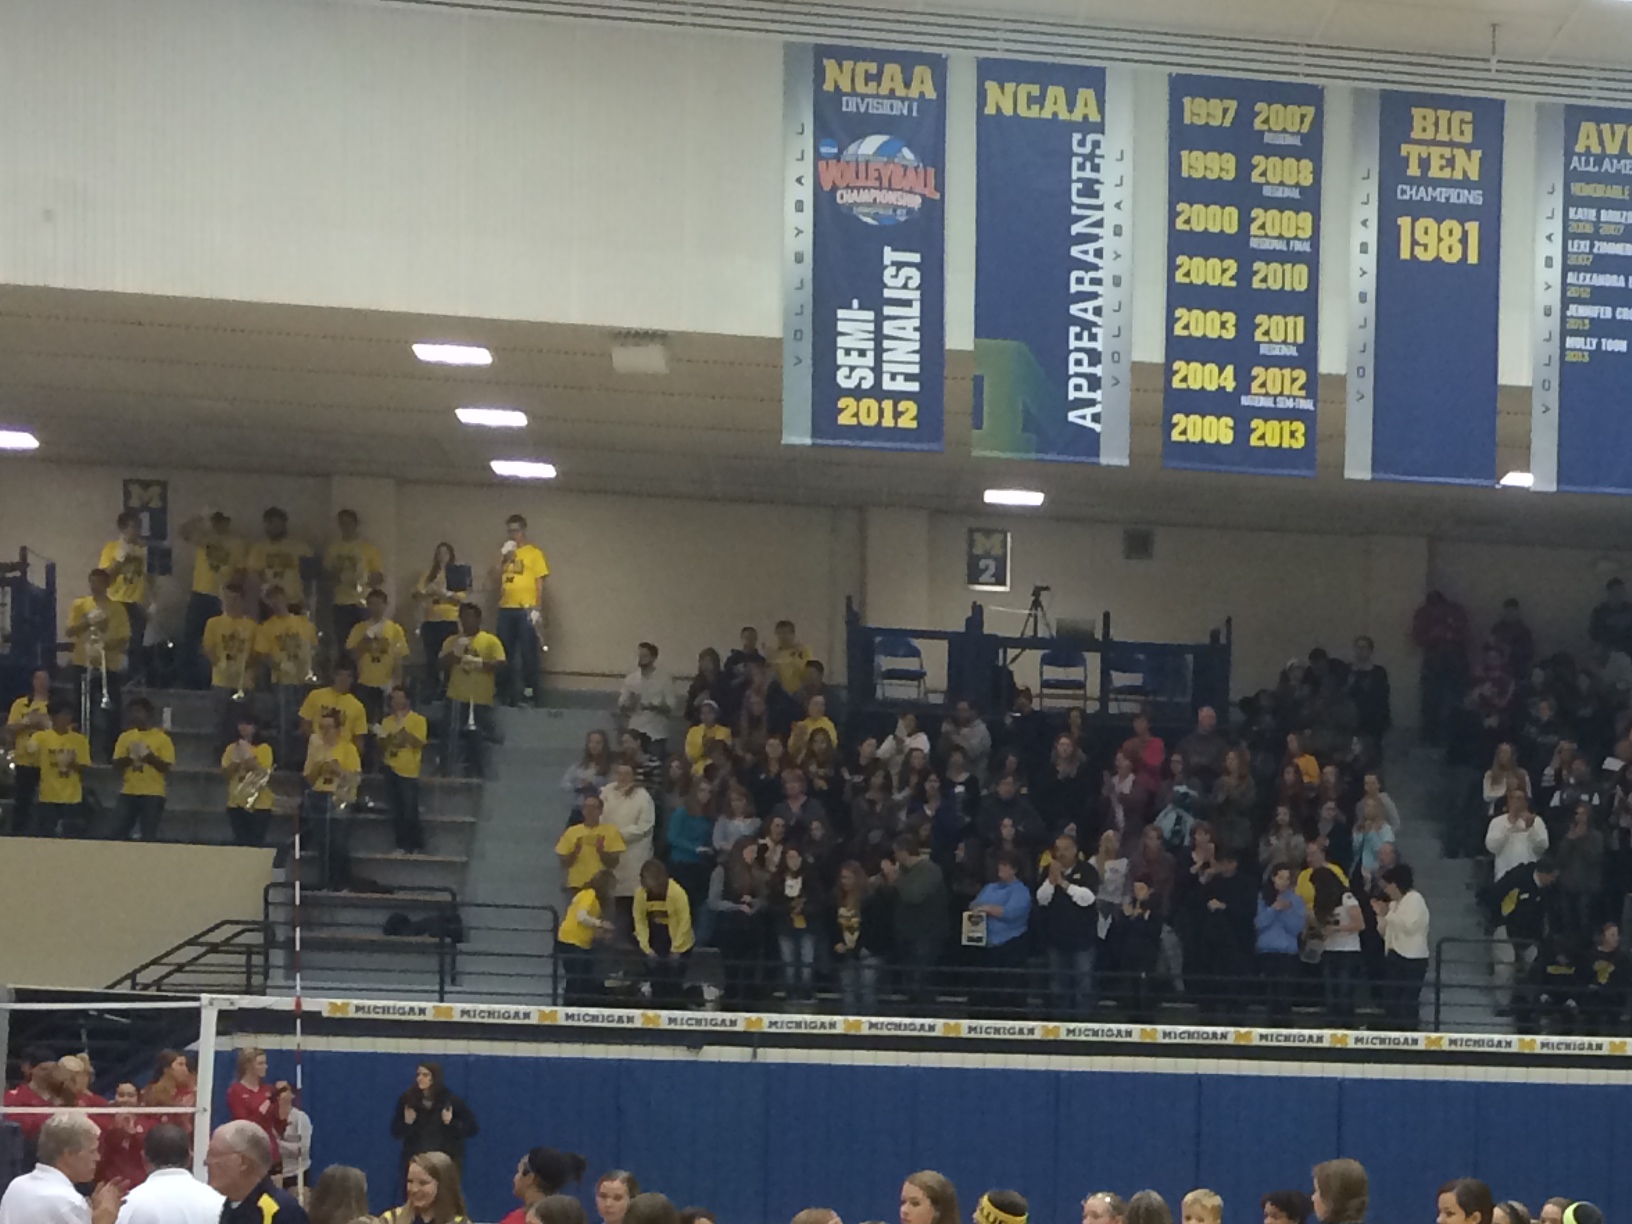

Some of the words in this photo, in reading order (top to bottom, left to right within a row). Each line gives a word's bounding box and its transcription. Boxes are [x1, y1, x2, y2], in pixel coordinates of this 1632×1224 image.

[822, 58, 937, 99] NCAA
[841, 96, 909, 117] DIVISION
[984, 80, 1102, 122] NCAA
[1182, 96, 1238, 127] 1997
[1253, 102, 1315, 133] 2007
[1410, 106, 1473, 143] BIG
[818, 159, 941, 200] VOLLEYBALL
[1180, 150, 1236, 180] 1999
[1251, 155, 1313, 186] 2008
[1401, 144, 1482, 181] TEN
[1569, 156, 1598, 173] ALL
[1396, 183, 1483, 206] CHAMPIONS
[1175, 202, 1239, 234] 2000
[1250, 208, 1313, 239] 2009
[793, 122, 805, 367] VOLLEYBALL
[1397, 216, 1479, 264] 1981
[1068, 132, 1105, 433] APPEARANCES
[1111, 149, 1124, 388] VOLLEYBALL
[1175, 255, 1238, 287] 2002
[1252, 261, 1308, 292] 2010
[1356, 168, 1370, 402] VOLLEYBALL
[1541, 183, 1555, 414] VOLLEYBALL
[881, 245, 922, 392] FINALIST
[1174, 307, 1237, 340] 2003
[1254, 314, 1304, 344] 2011
[836, 298, 875, 390] SEMI-
[1172, 360, 1236, 392] 2004
[1251, 366, 1307, 396] 2012
[837, 396, 918, 429] 2012
[1170, 413, 1234, 444] 2006
[1249, 418, 1305, 449] 2013
[979, 559, 996, 583] 2
[354, 1005, 427, 1018] MICHIGAN
[459, 1008, 532, 1022] MICHIGAN
[564, 1013, 635, 1025] MICHIGAN
[667, 1017, 738, 1029] MICHIGAN
[767, 1020, 837, 1031] MICHIGAN
[867, 1022, 937, 1034] MICHIGAN
[966, 1025, 1036, 1037] MICHIGAN
[1065, 1028, 1133, 1039] MICHIGAN
[1162, 1031, 1229, 1041] MICHIGAN
[1258, 1033, 1325, 1045] MICHIGAN
[1353, 1036, 1419, 1048] MICHIGAN
[1448, 1038, 1513, 1050] MICHIGAN
[1539, 1041, 1604, 1053] MICHIGAN
